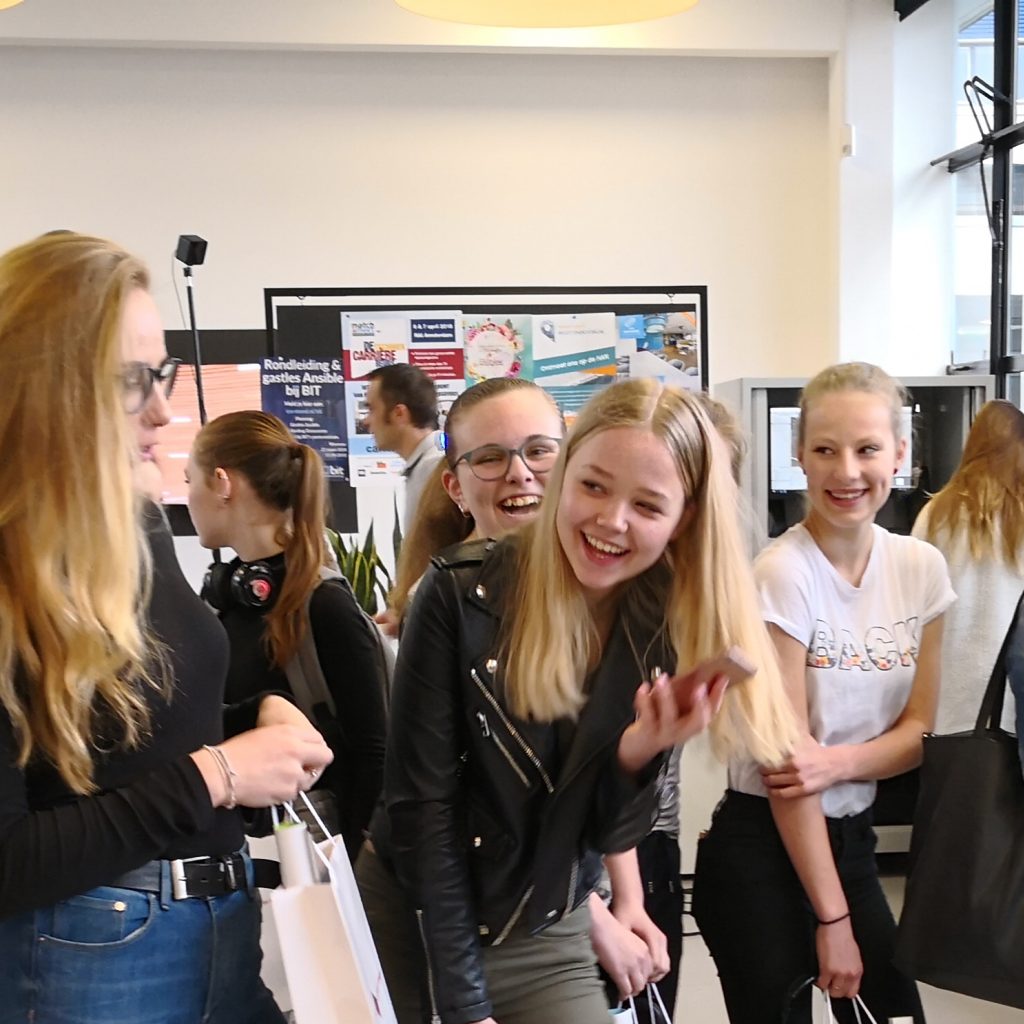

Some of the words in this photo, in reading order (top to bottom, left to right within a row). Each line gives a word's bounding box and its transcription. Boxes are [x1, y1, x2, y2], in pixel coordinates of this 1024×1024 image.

[264, 358, 330, 373] Rondleiding
[331, 359, 342, 371] &
[262, 371, 301, 386] gastles
[302, 371, 344, 384] Ansible
[284, 384, 300, 398] bij
[301, 384, 322, 396] BIT
